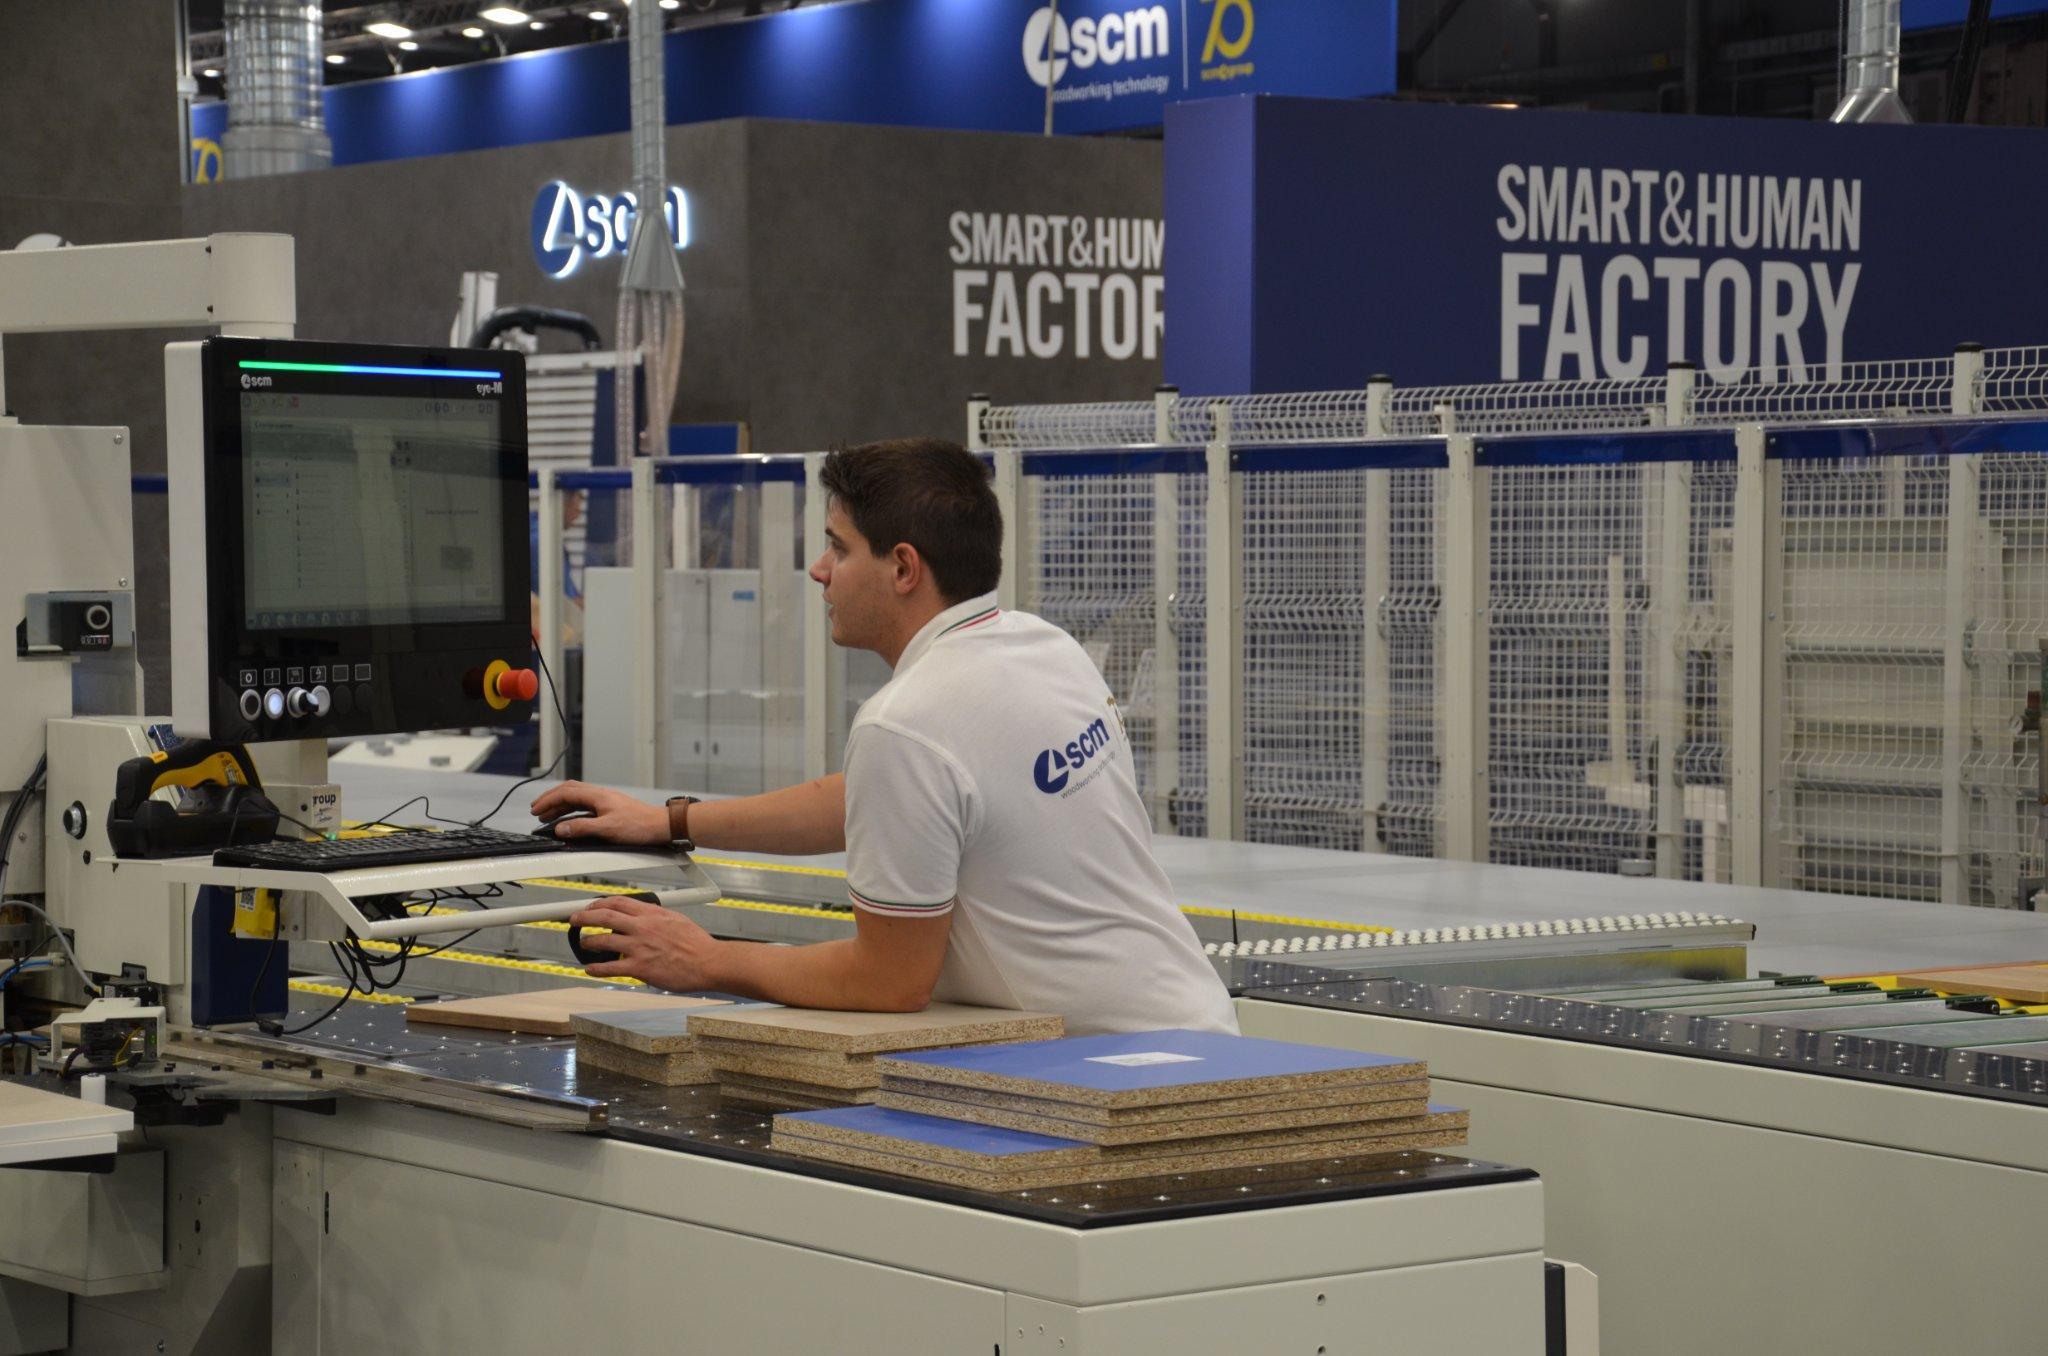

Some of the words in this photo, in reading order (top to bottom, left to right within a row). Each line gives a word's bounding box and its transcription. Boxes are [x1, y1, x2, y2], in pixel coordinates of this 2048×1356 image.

[1071, 5, 1169, 69] scm
[1053, 81, 1112, 102] oodworking
[1113, 74, 1169, 95] technology
[1500, 252, 1862, 386] FACTORY
[1065, 718, 1110, 769] scm
